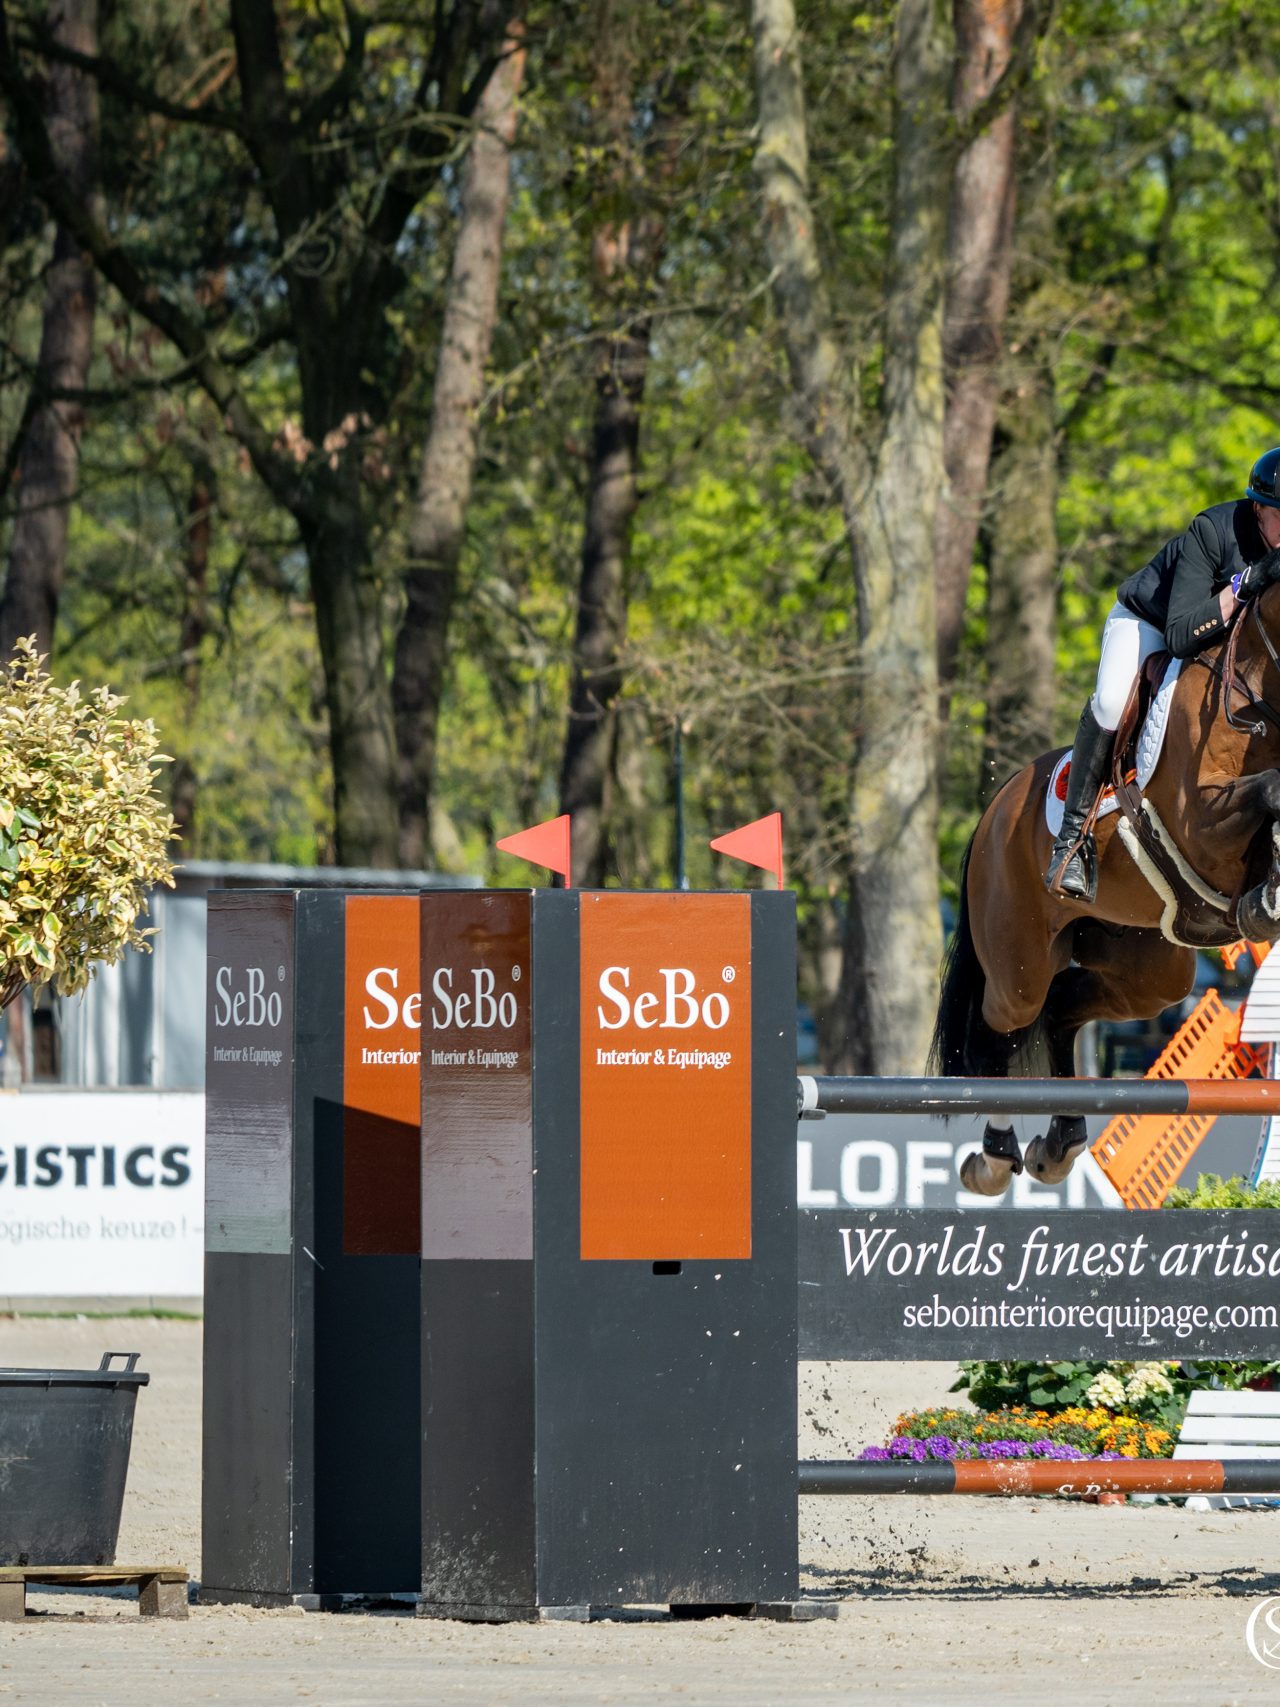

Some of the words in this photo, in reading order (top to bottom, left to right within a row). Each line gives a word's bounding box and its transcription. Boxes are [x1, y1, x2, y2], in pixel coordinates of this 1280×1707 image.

[213, 1046, 242, 1063] Interior
[249, 1047, 283, 1067] Equipage
[361, 1047, 421, 1065] Interior
[432, 1049, 468, 1065] Interior
[467, 1050, 476, 1065] &
[477, 1050, 519, 1069] Equipage
[597, 1048, 652, 1066] Interior
[654, 1050, 666, 1066] &
[667, 1050, 732, 1070] Equipage
[0, 1144, 192, 1188] ISTICS
[838, 1225, 1004, 1277] Worlds
[1007, 1226, 1149, 1291] finest
[902, 1294, 1279, 1338] sebointeriorequipage.com
